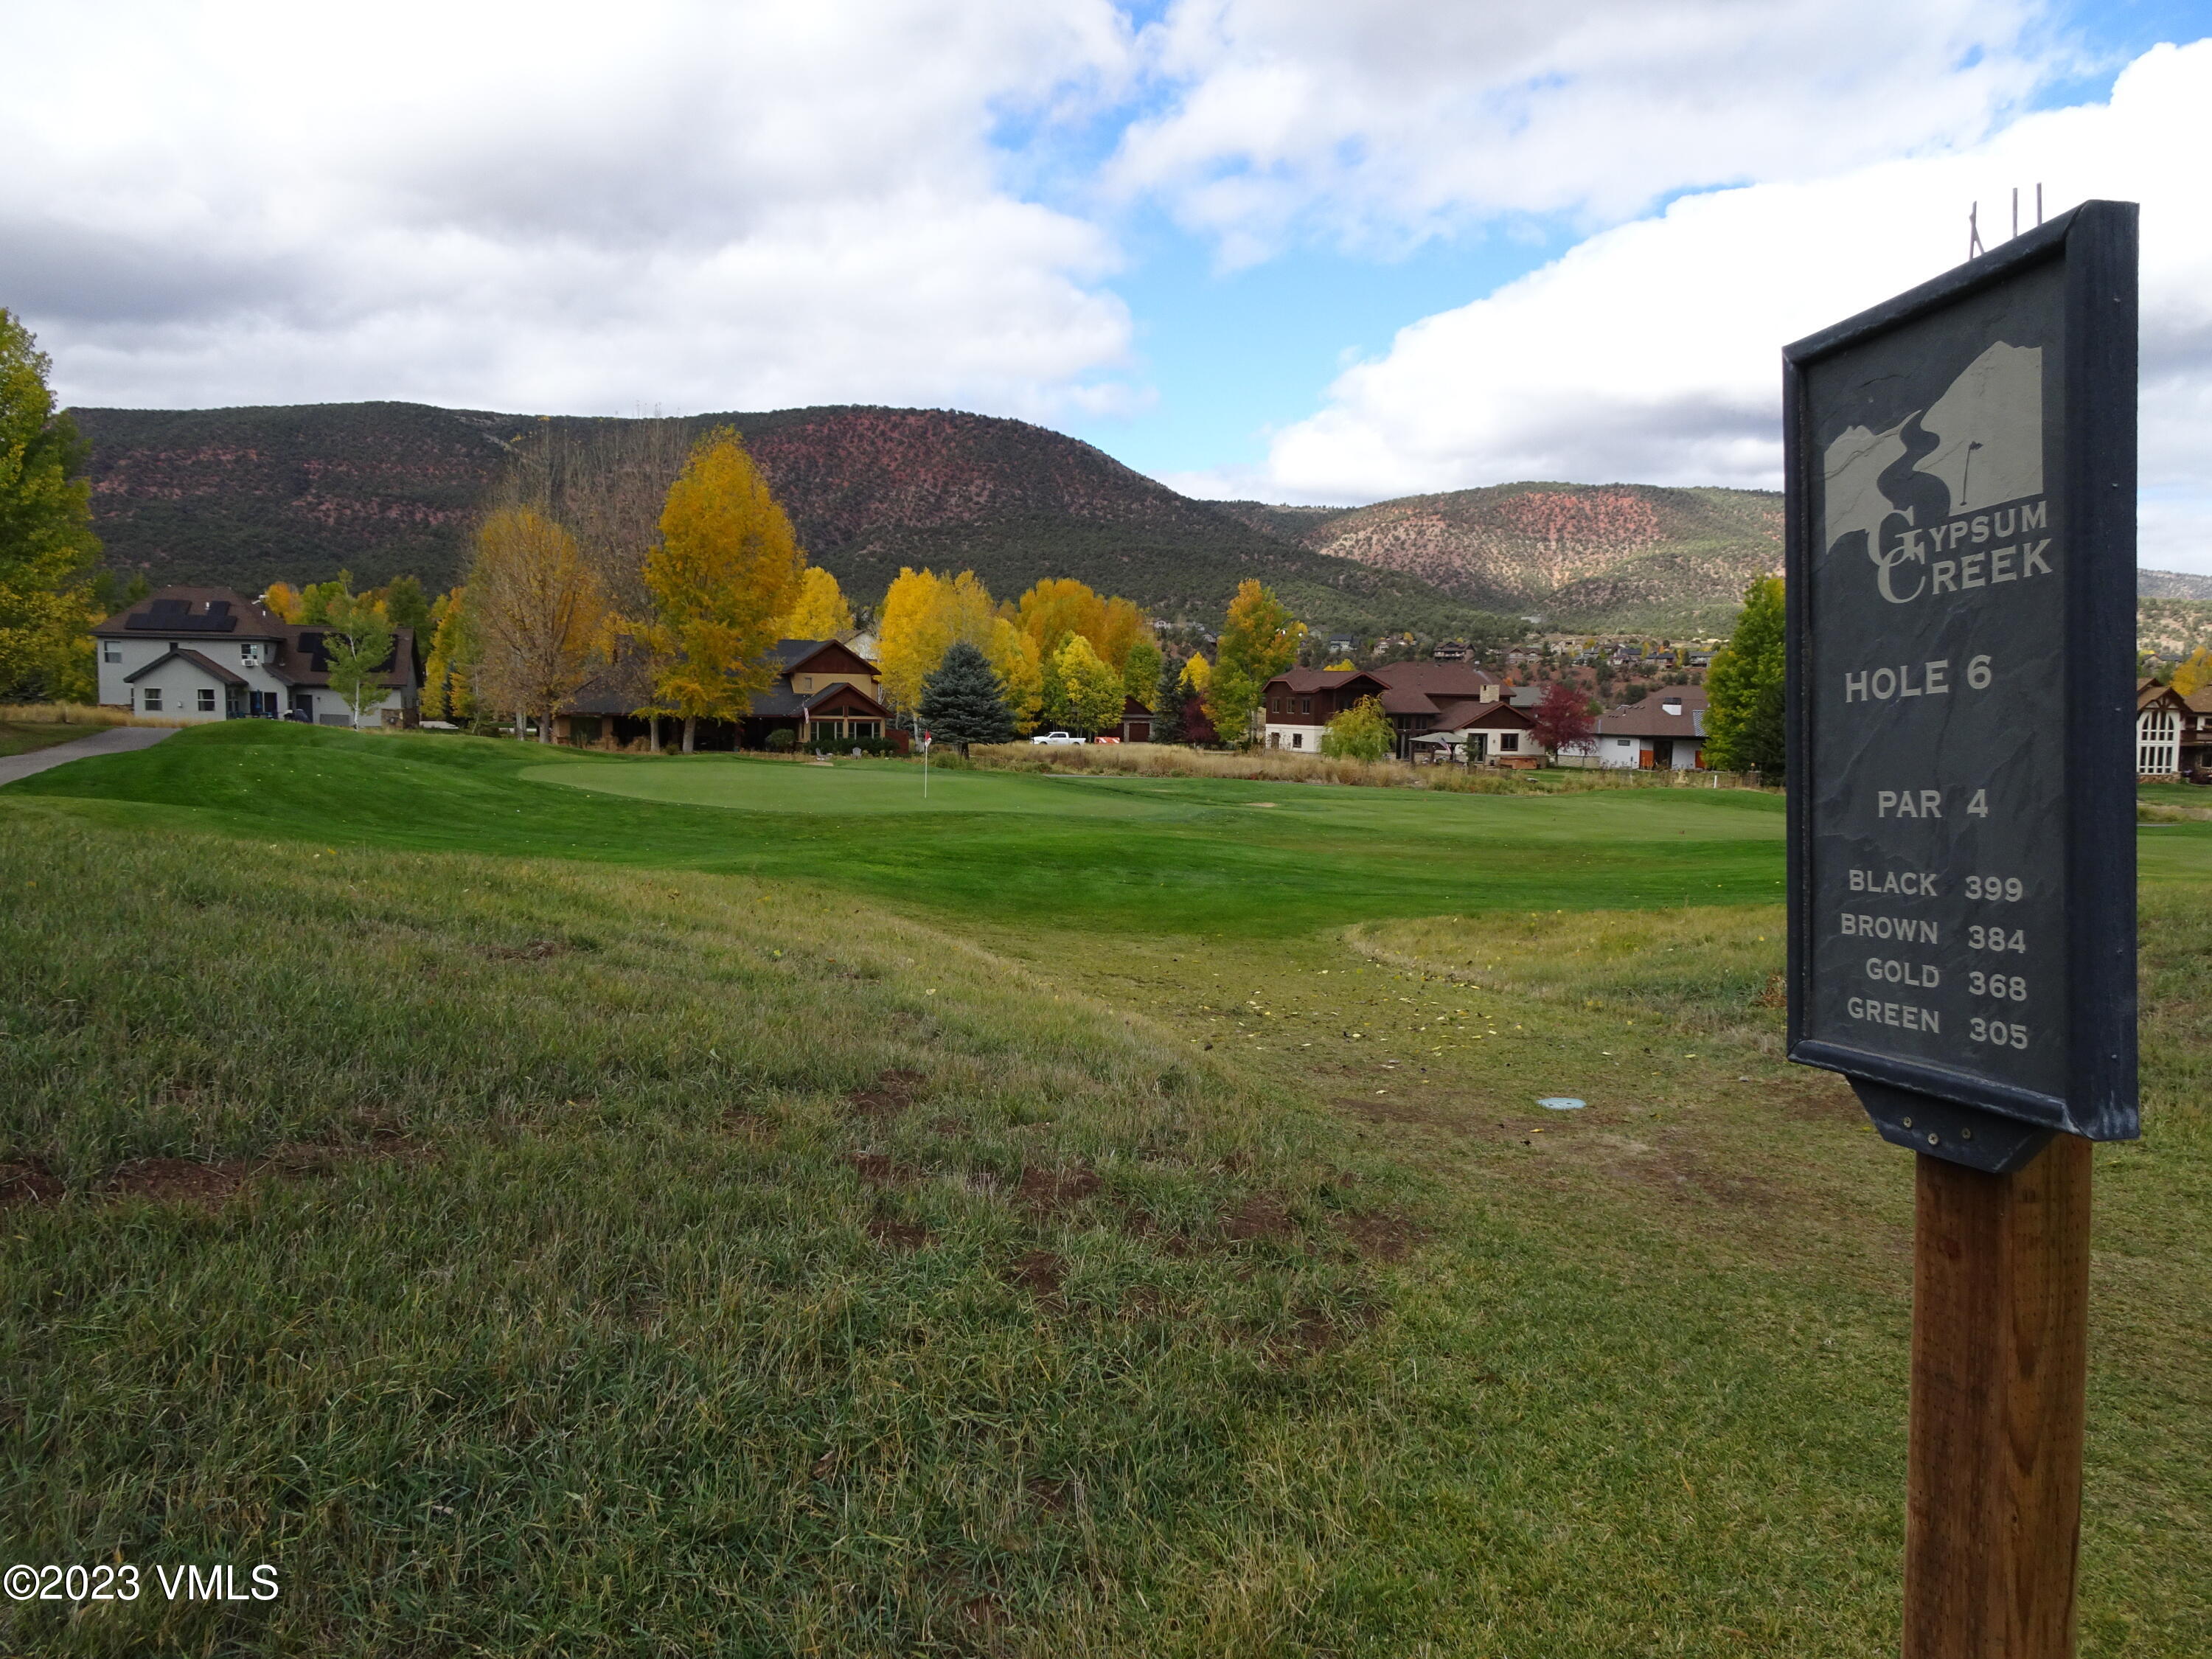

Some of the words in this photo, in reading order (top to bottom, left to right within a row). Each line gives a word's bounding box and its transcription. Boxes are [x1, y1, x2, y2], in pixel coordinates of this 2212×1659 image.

[1867, 501, 2047, 566] GYPSUM
[1877, 538, 2053, 604] CREEK
[1846, 660, 1949, 703] HOLE
[1967, 655, 1992, 689] 6
[1878, 790, 1942, 818] PAR
[1967, 789, 1988, 818] 4
[1848, 869, 1937, 896] BLACK
[1965, 876, 2023, 902] 399
[1841, 913, 1938, 944] BROWN
[1968, 925, 2025, 953] 384
[1865, 958, 1940, 988] GOLD
[1969, 972, 2027, 1001] 368
[1847, 997, 1939, 1033] GREEN
[1969, 1018, 2028, 1049] 305
